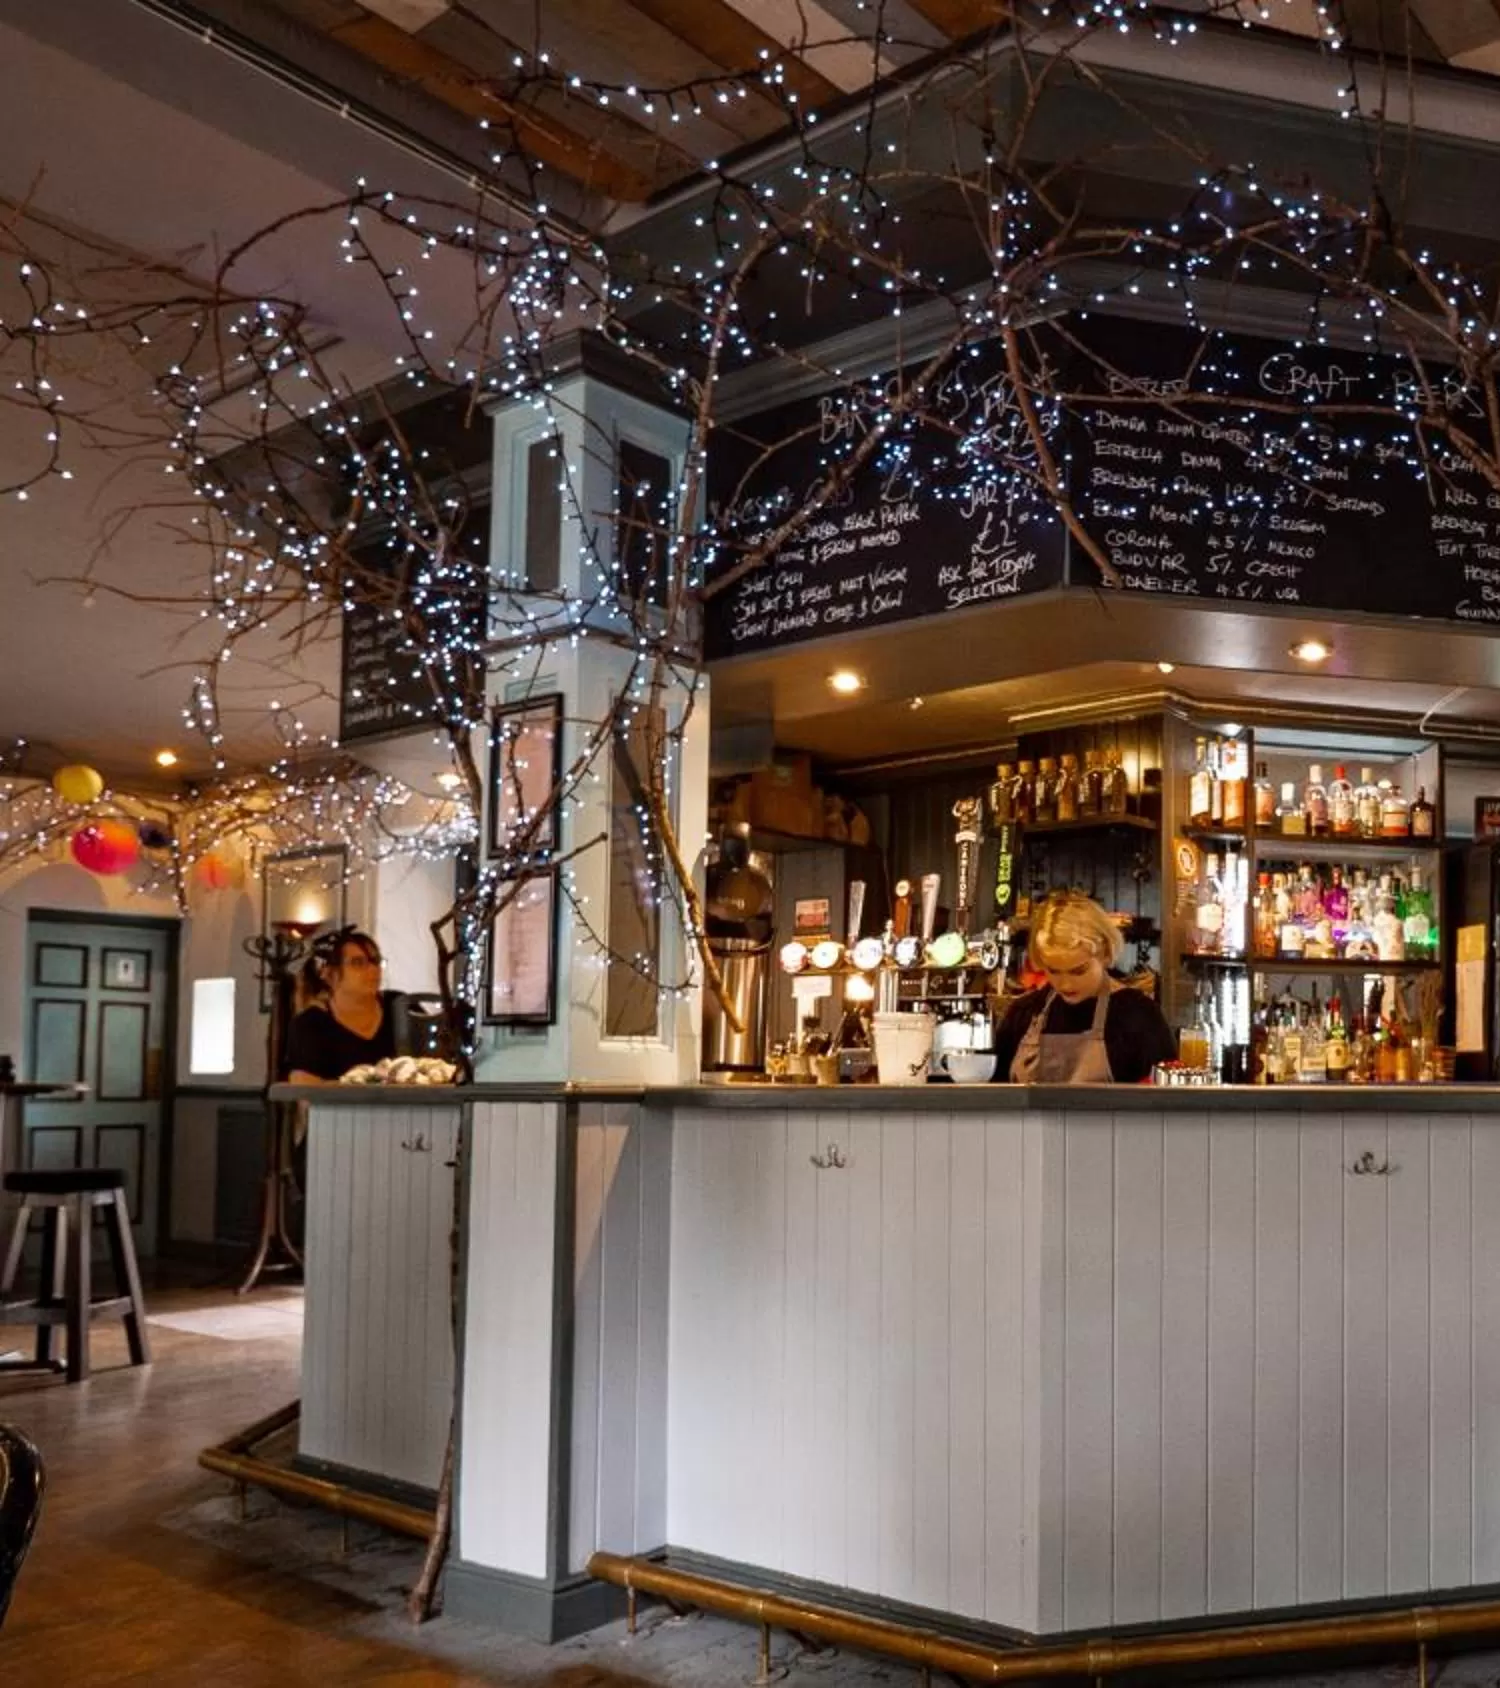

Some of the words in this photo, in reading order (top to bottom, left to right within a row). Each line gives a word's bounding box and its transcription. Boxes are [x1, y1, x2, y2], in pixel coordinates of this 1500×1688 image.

[1259, 353, 1361, 398] CRAFT
[1104, 529, 1173, 551] CORONA
[1267, 540, 1317, 560] MEXICO
[1110, 549, 1190, 575] BUDVAR
